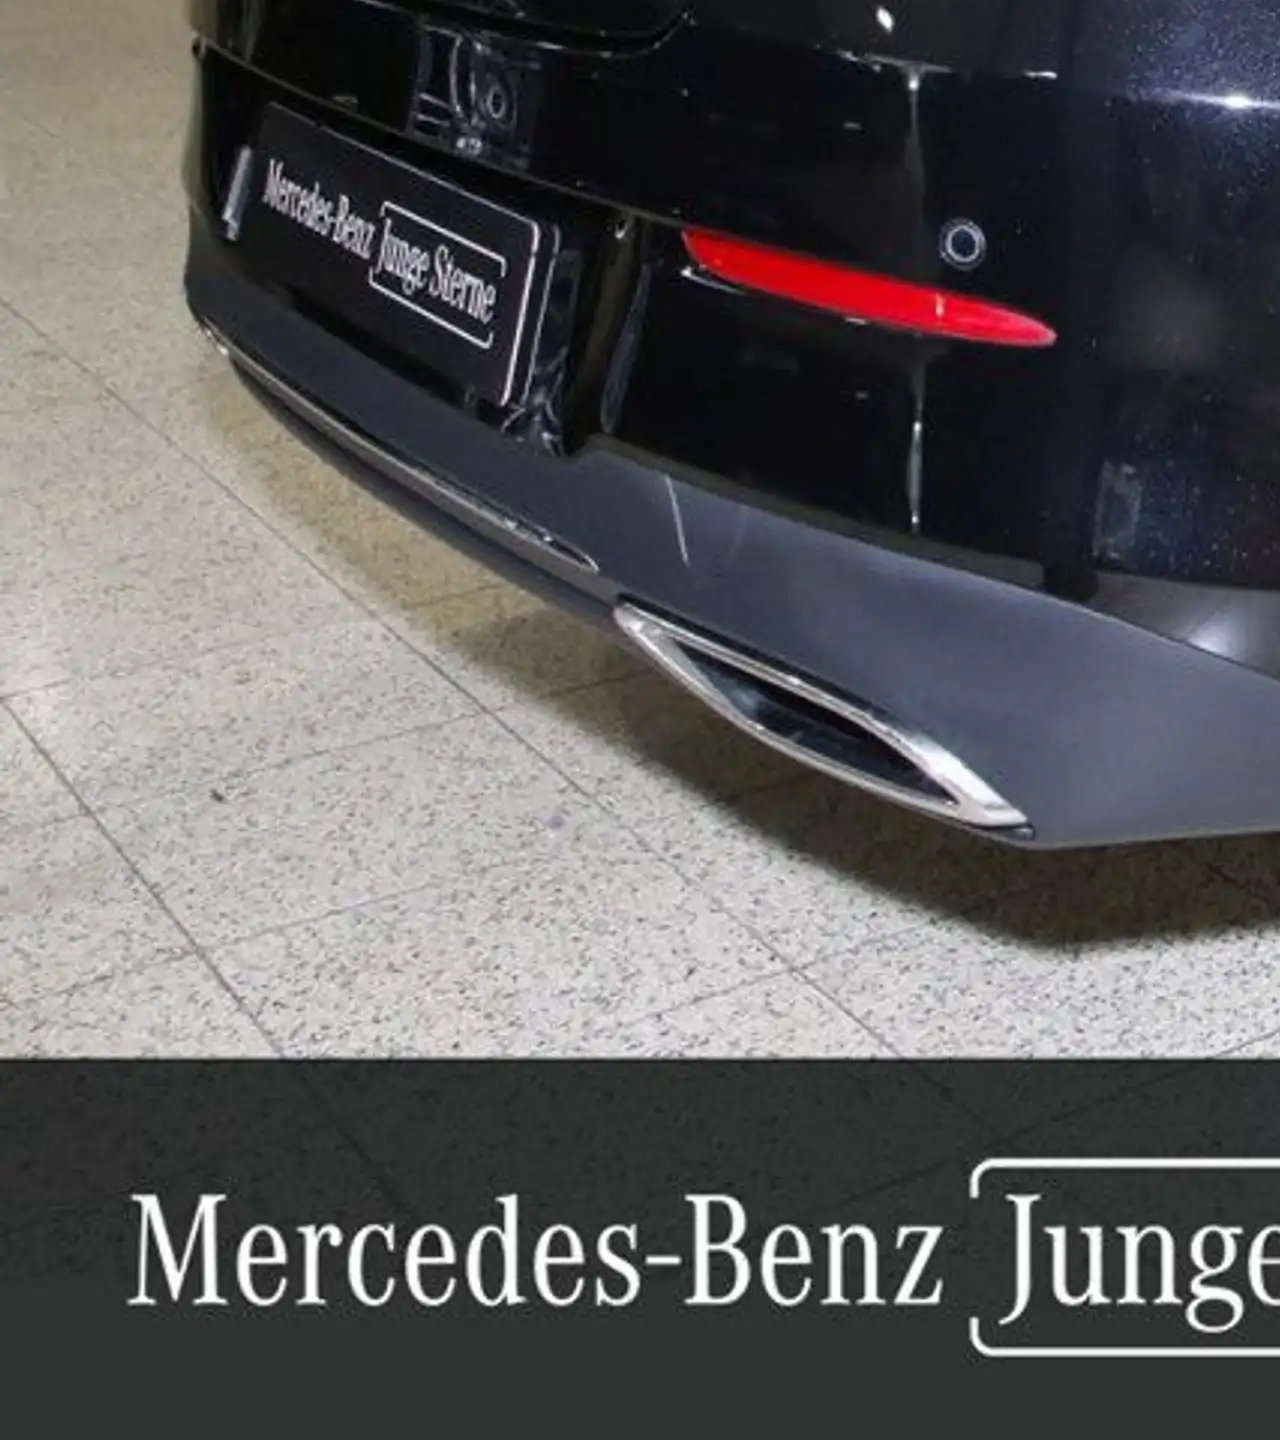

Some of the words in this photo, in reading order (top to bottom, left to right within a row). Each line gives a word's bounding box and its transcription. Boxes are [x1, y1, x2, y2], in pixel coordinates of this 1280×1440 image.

[263, 158, 374, 260] Mercedes-Benz
[376, 218, 429, 295] Junge
[430, 245, 497, 324] Sterne
